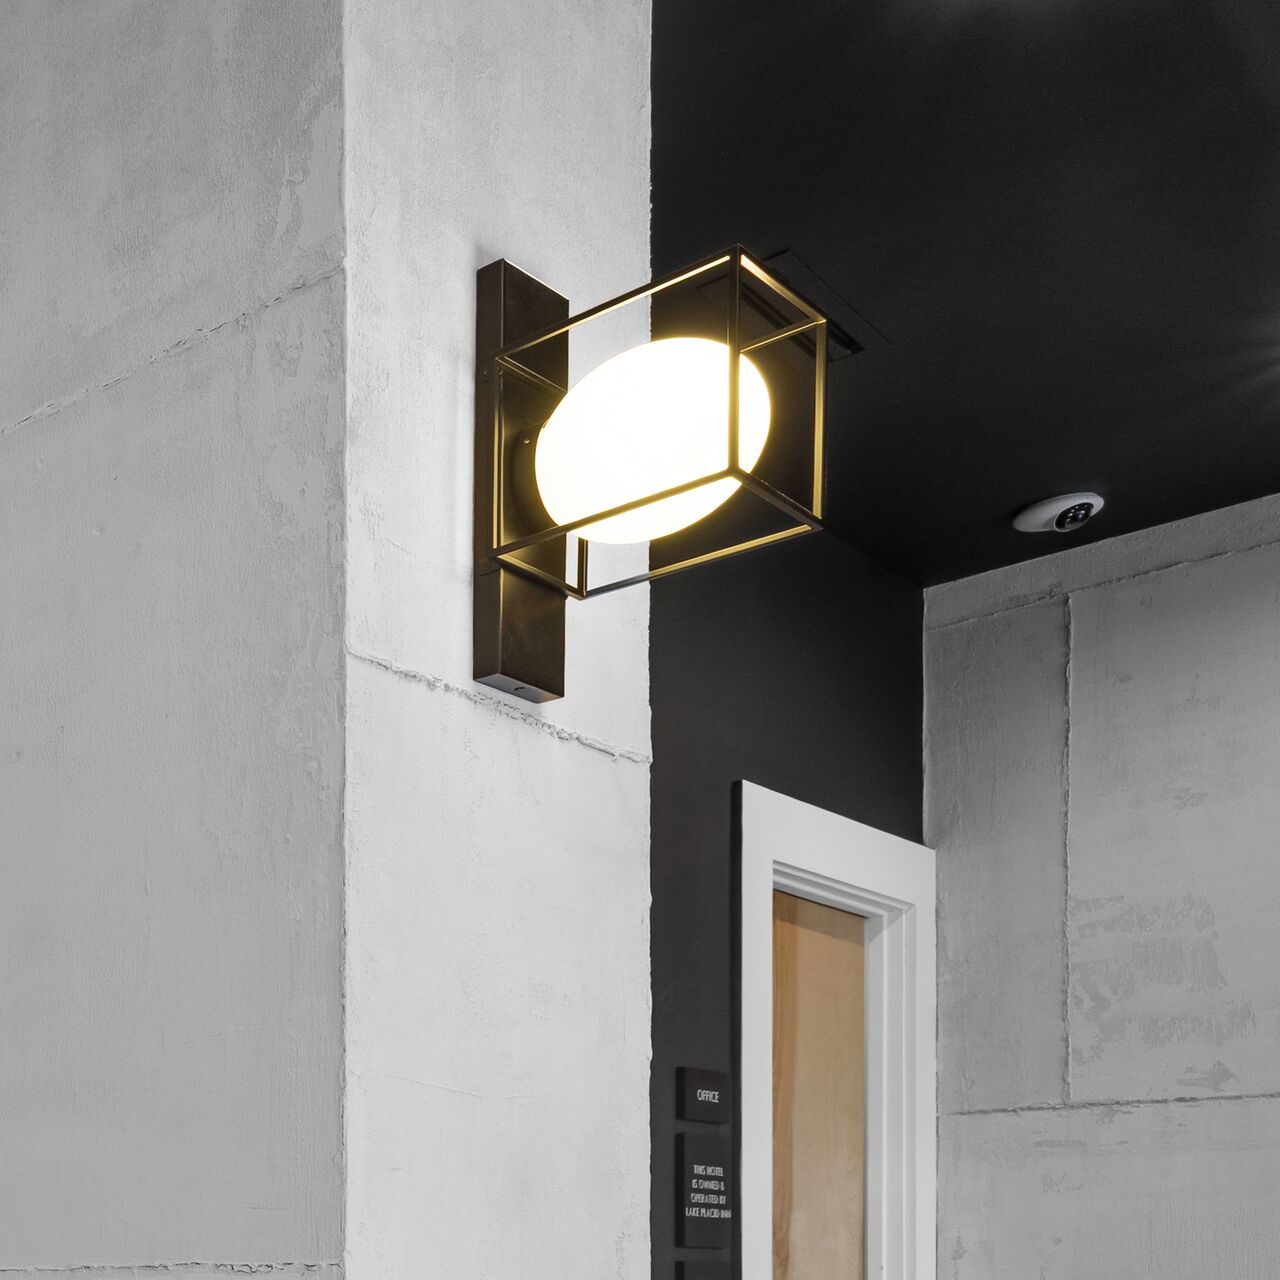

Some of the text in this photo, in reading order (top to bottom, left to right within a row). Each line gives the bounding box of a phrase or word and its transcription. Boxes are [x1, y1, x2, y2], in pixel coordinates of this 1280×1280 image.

[697, 1089, 719, 1103] OFFICE
[693, 1165, 724, 1177] THIS HOTEL
[692, 1179, 698, 1188] IS
[699, 1179, 719, 1190] OWNED
[690, 1193, 726, 1205] OPERATED BY
[685, 1207, 732, 1218] LAKE PLACID INN
